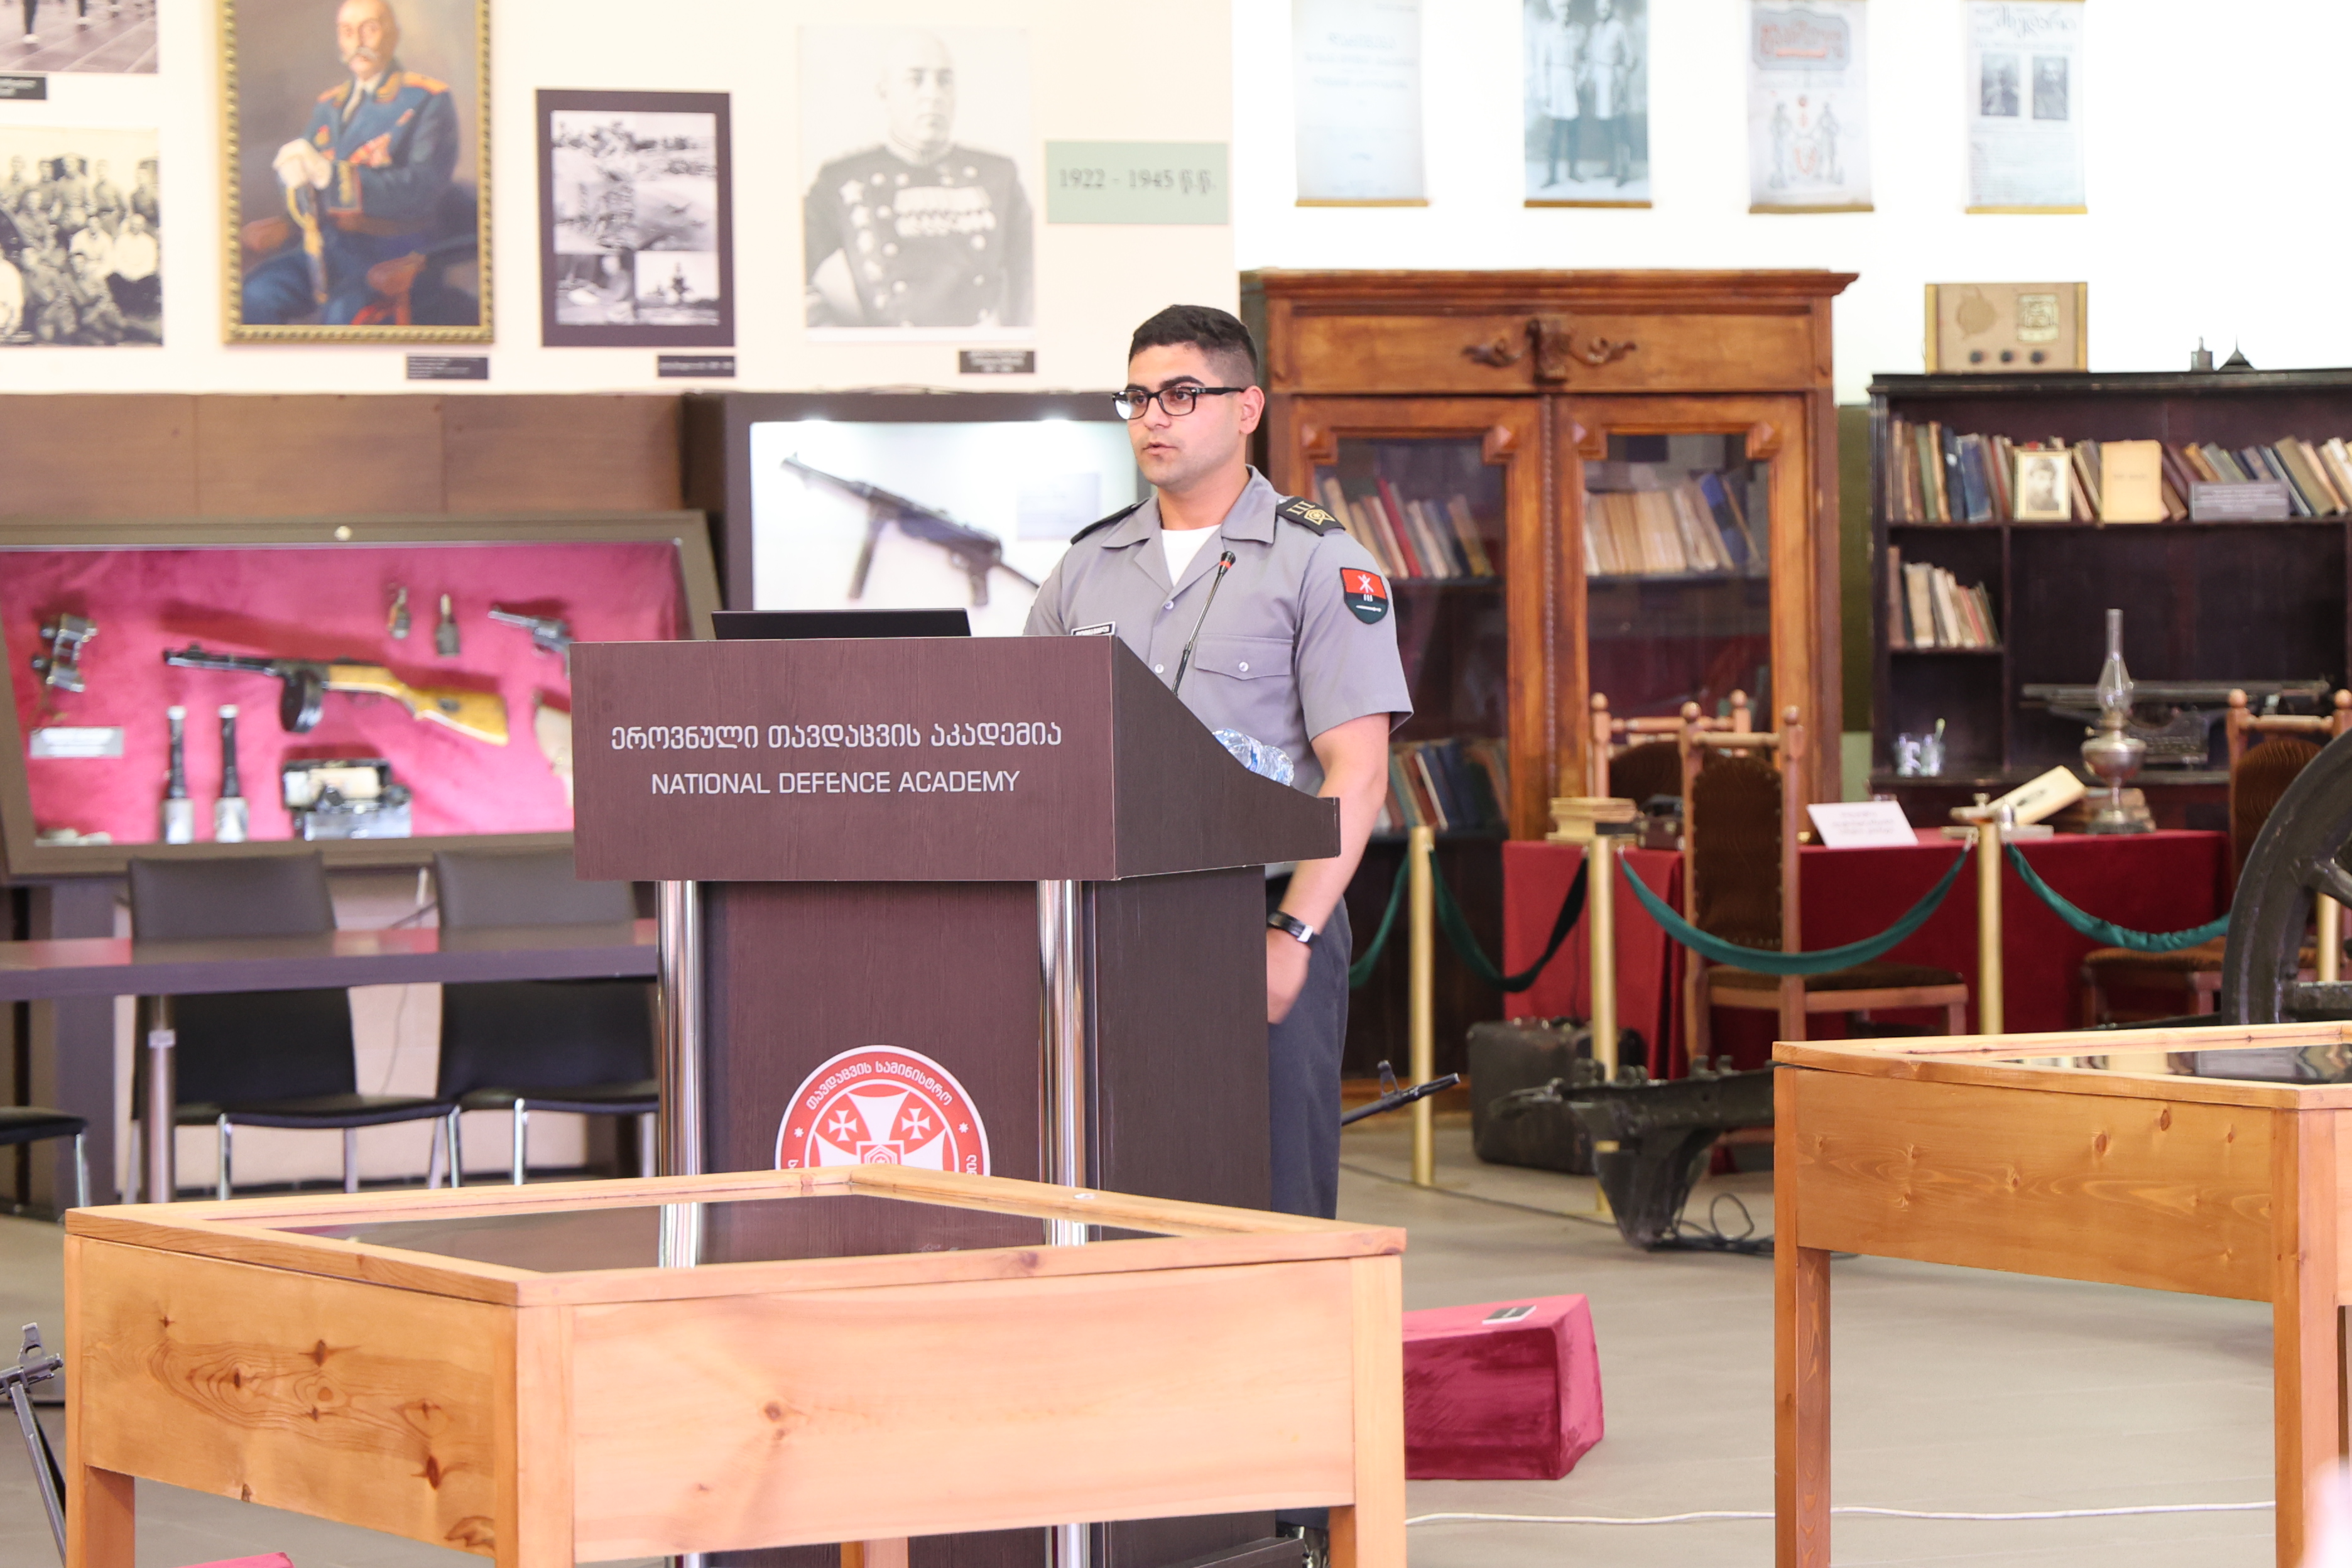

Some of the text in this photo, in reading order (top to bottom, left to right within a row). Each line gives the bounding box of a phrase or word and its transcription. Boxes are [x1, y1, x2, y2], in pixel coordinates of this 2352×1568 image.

[1060, 168, 1106, 189] 1922
[1129, 168, 1174, 189] 1945
[611, 722, 1062, 749] ეროვნული თავდაცვის აკადემია
[652, 770, 1020, 794] NATIONAL DEFENCE ACADEMY
[805, 1061, 953, 1110] თავდაცვის სამინისტრო
